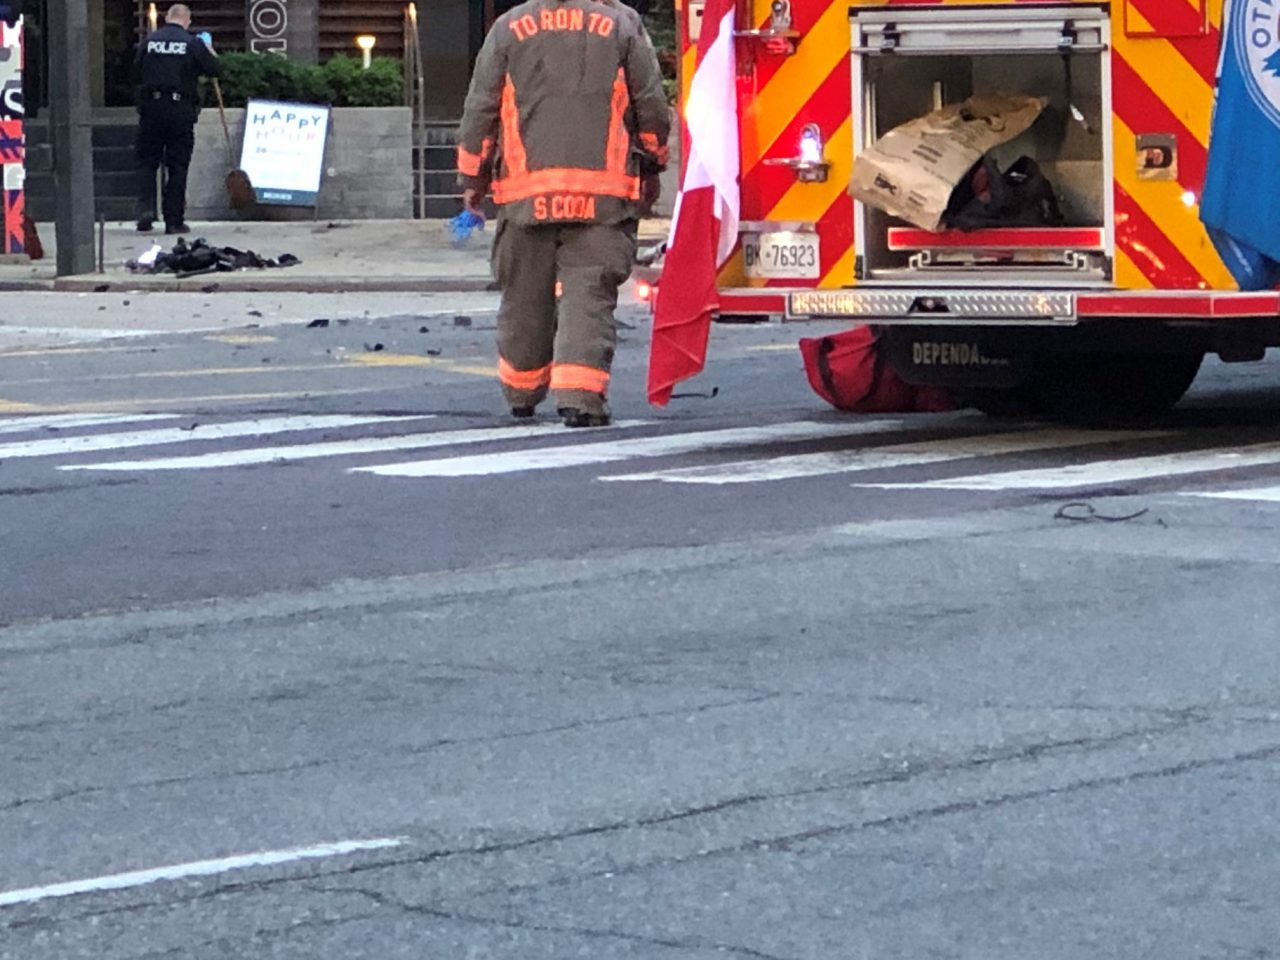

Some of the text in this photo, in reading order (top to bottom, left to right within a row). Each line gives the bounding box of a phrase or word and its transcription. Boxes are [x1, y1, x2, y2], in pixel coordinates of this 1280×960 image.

[148, 41, 187, 54] POLICE
[253, 110, 321, 129] HAPPY
[772, 244, 815, 266] 76923
[913, 342, 1008, 365] DEPENDA
